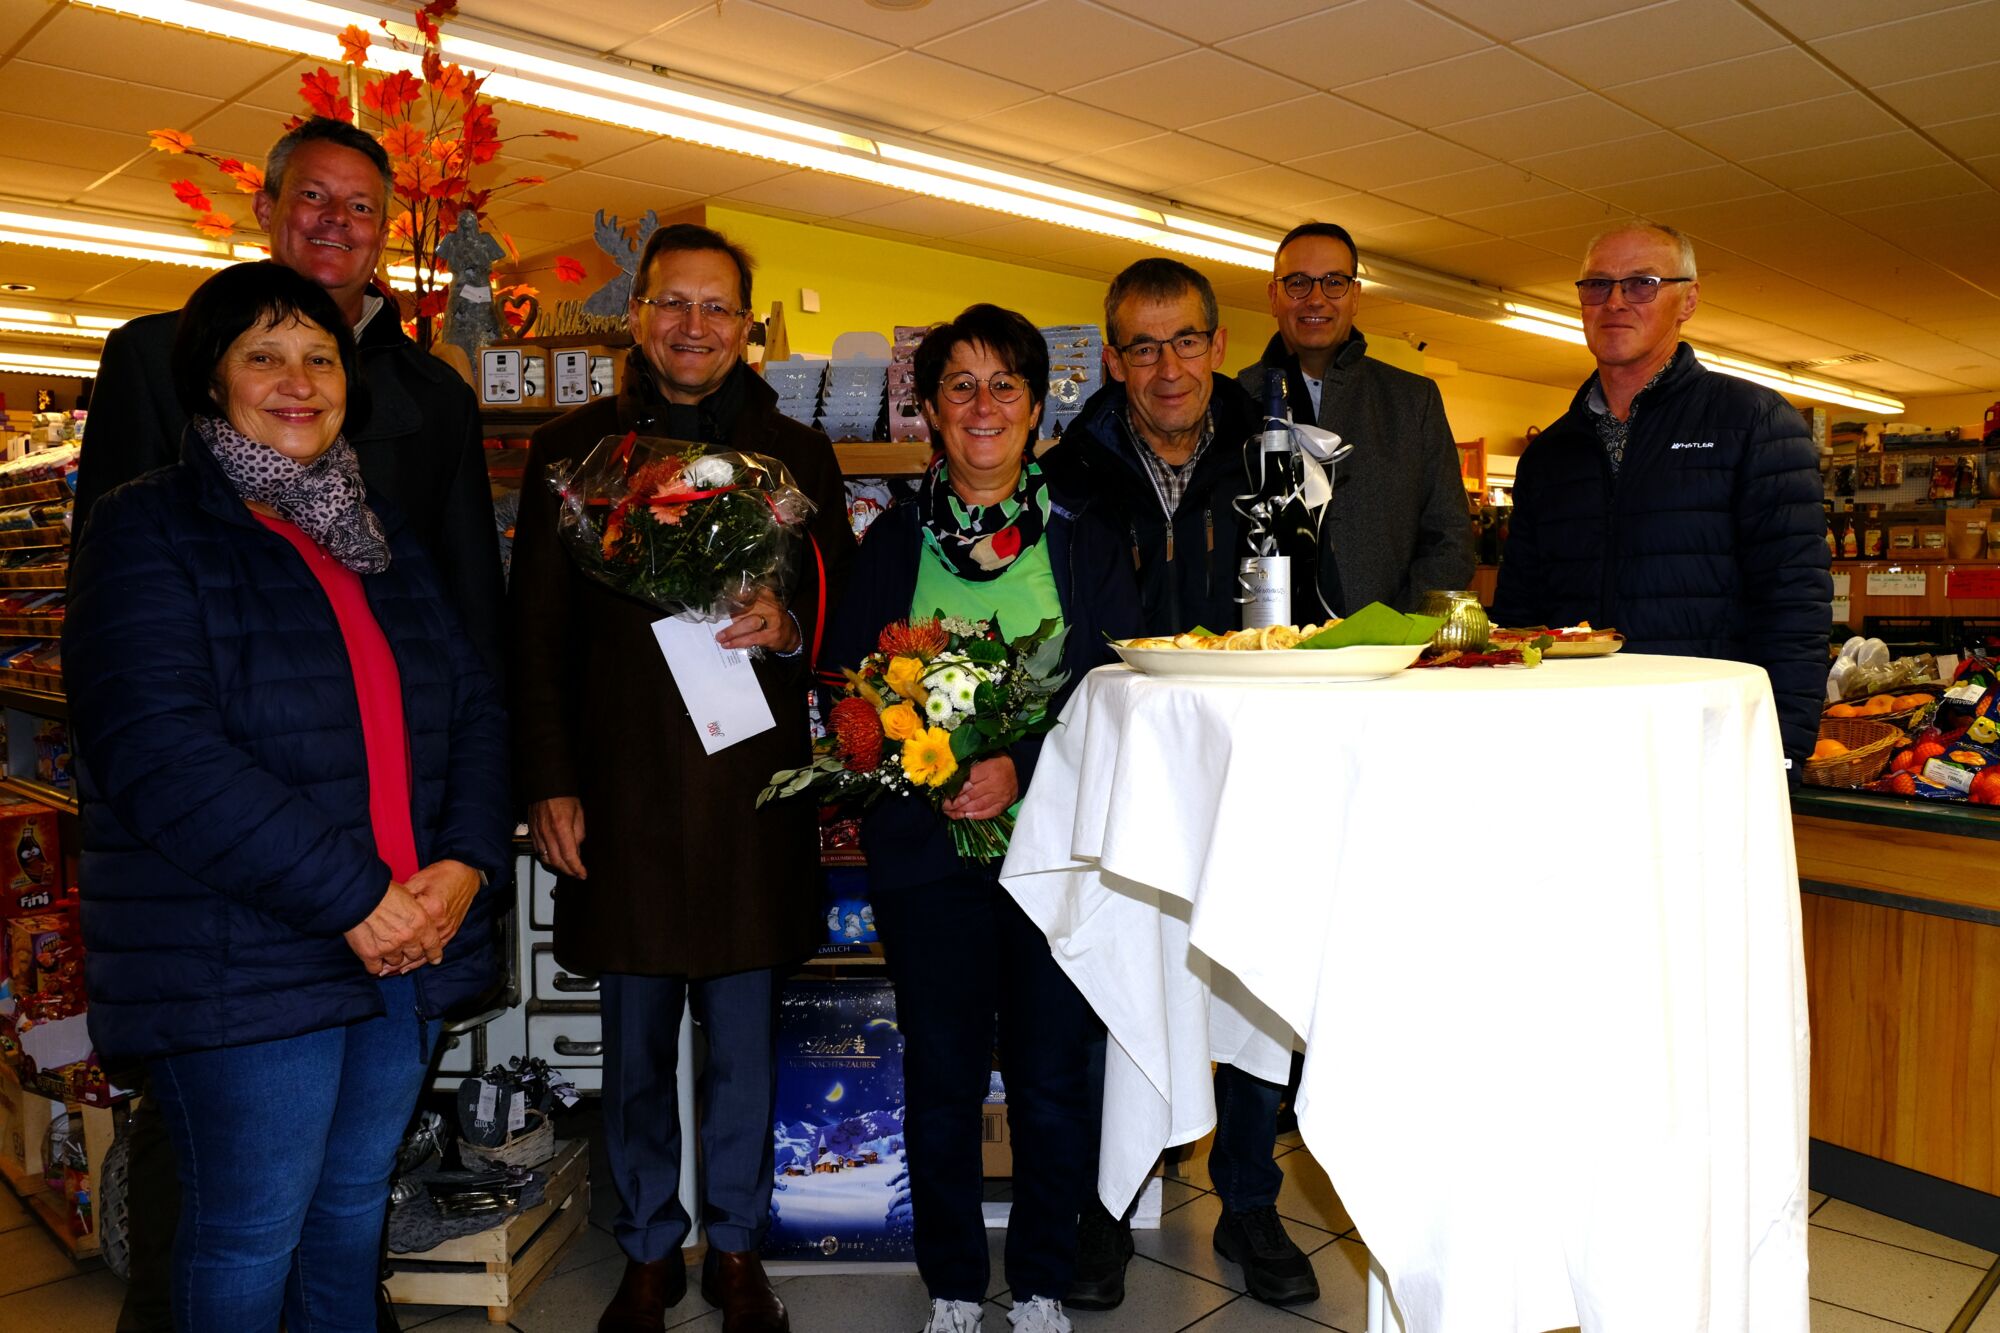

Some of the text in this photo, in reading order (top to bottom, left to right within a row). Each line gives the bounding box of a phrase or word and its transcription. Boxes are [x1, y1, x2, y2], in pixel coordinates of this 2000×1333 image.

[534, 299, 630, 337] Willkomme
[20, 891, 49, 908] Fini
[802, 1036, 853, 1054] Lindt
